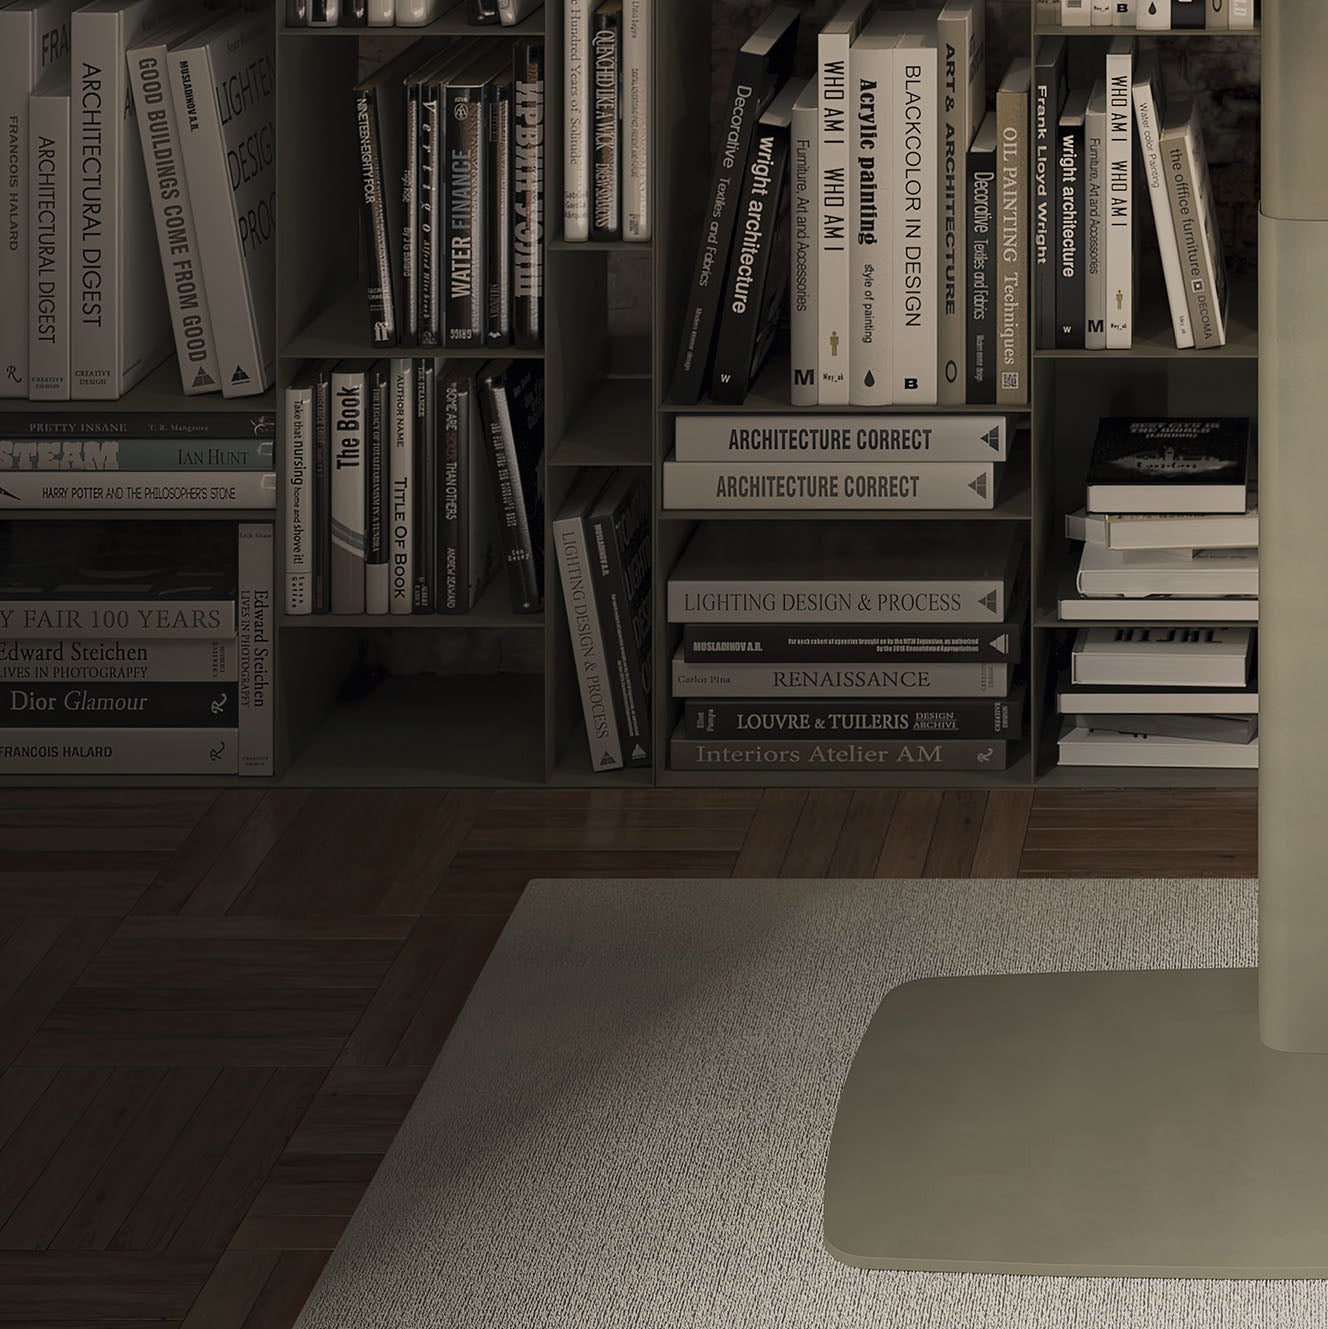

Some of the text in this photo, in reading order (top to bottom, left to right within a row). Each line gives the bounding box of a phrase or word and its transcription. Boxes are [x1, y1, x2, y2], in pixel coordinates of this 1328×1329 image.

[823, 60, 845, 100] WHO
[823, 107, 845, 132] AM
[857, 78, 878, 245] Acrylic painting
[1035, 84, 1049, 265] Frank Lloyd Wright
[82, 62, 102, 328] ARCHITECTURAL DIGEST
[823, 167, 845, 207] WHO
[823, 214, 845, 239] AM
[999, 126, 1020, 365] OIL PAINTING Techniques
[861, 263, 875, 344] style of painting
[336, 384, 360, 470] The Book
[728, 428, 933, 450] ARCHITECTURE CORRECT
[393, 476, 408, 599] TITLE OF BOOK
[684, 592, 961, 612] LIGHTING DESIGN & PROCESS
[773, 671, 931, 688] RENAISSANCE
[9, 688, 150, 712] Dior Glamour
[736, 712, 909, 730] LOUVRE & TUILERIS
[695, 744, 943, 763] Interiors Atelier AM
